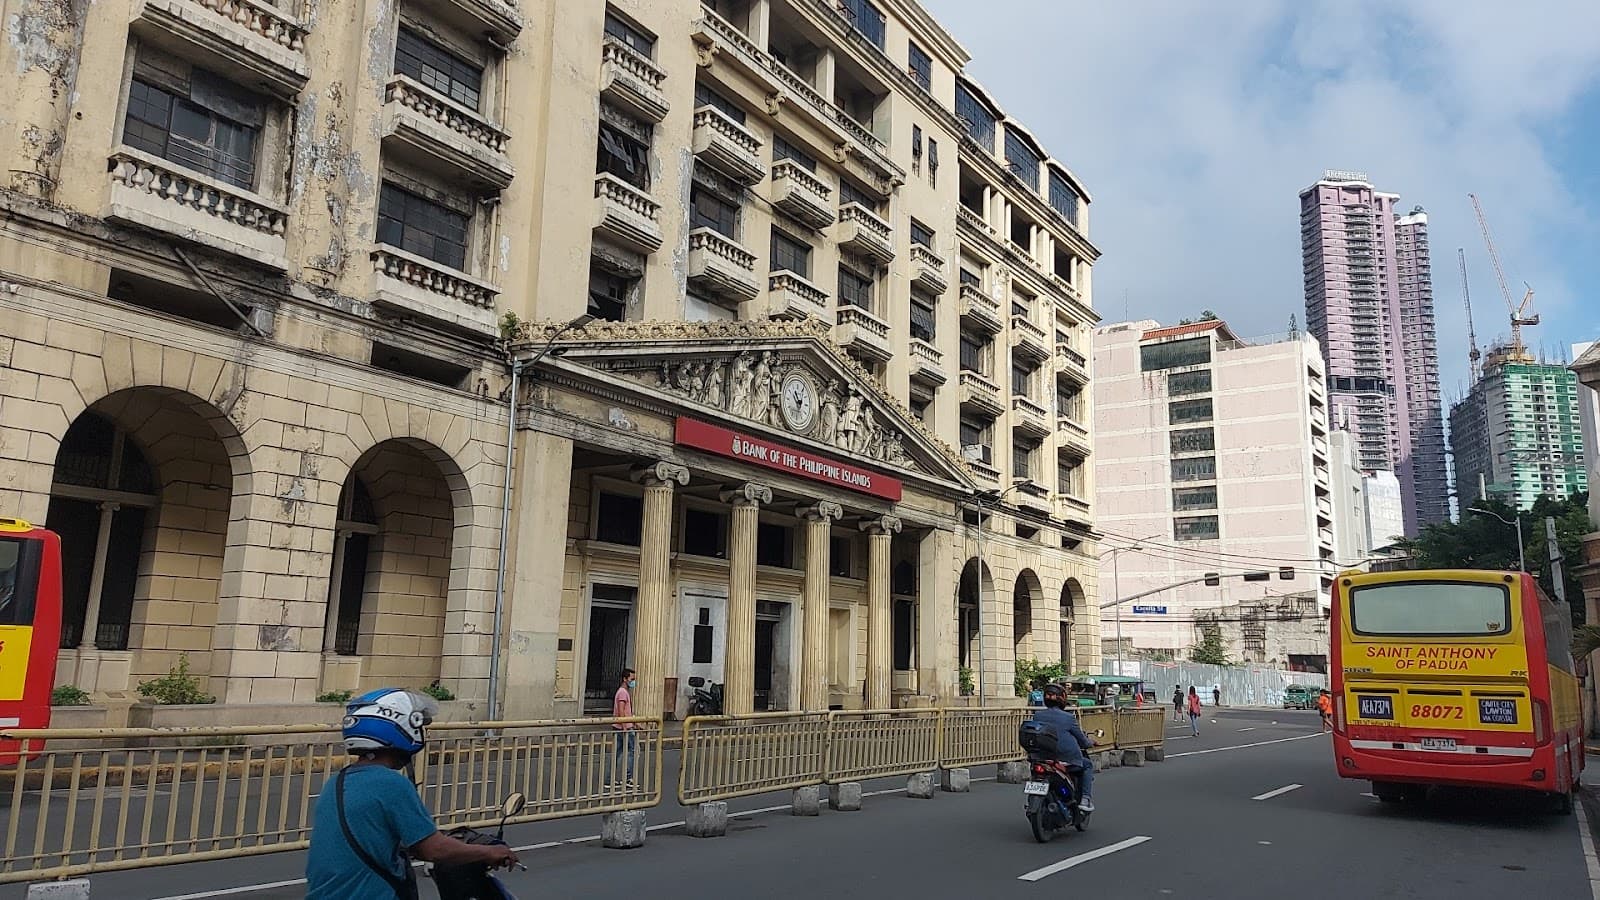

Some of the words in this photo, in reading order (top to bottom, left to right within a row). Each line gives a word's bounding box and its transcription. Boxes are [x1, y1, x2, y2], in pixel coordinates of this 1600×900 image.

[742, 440, 768, 460] BANK
[770, 449, 780, 463] OF
[782, 452, 798, 468] THE
[799, 456, 840, 480] PHILIPPINE
[841, 468, 871, 489] ISLANDS
[1366, 646, 1412, 658] SAINT
[1416, 647, 1497, 659] ANTHONY
[1395, 659, 1414, 669] OF
[1418, 660, 1468, 670] PADUA
[1411, 704, 1464, 720] 88072
